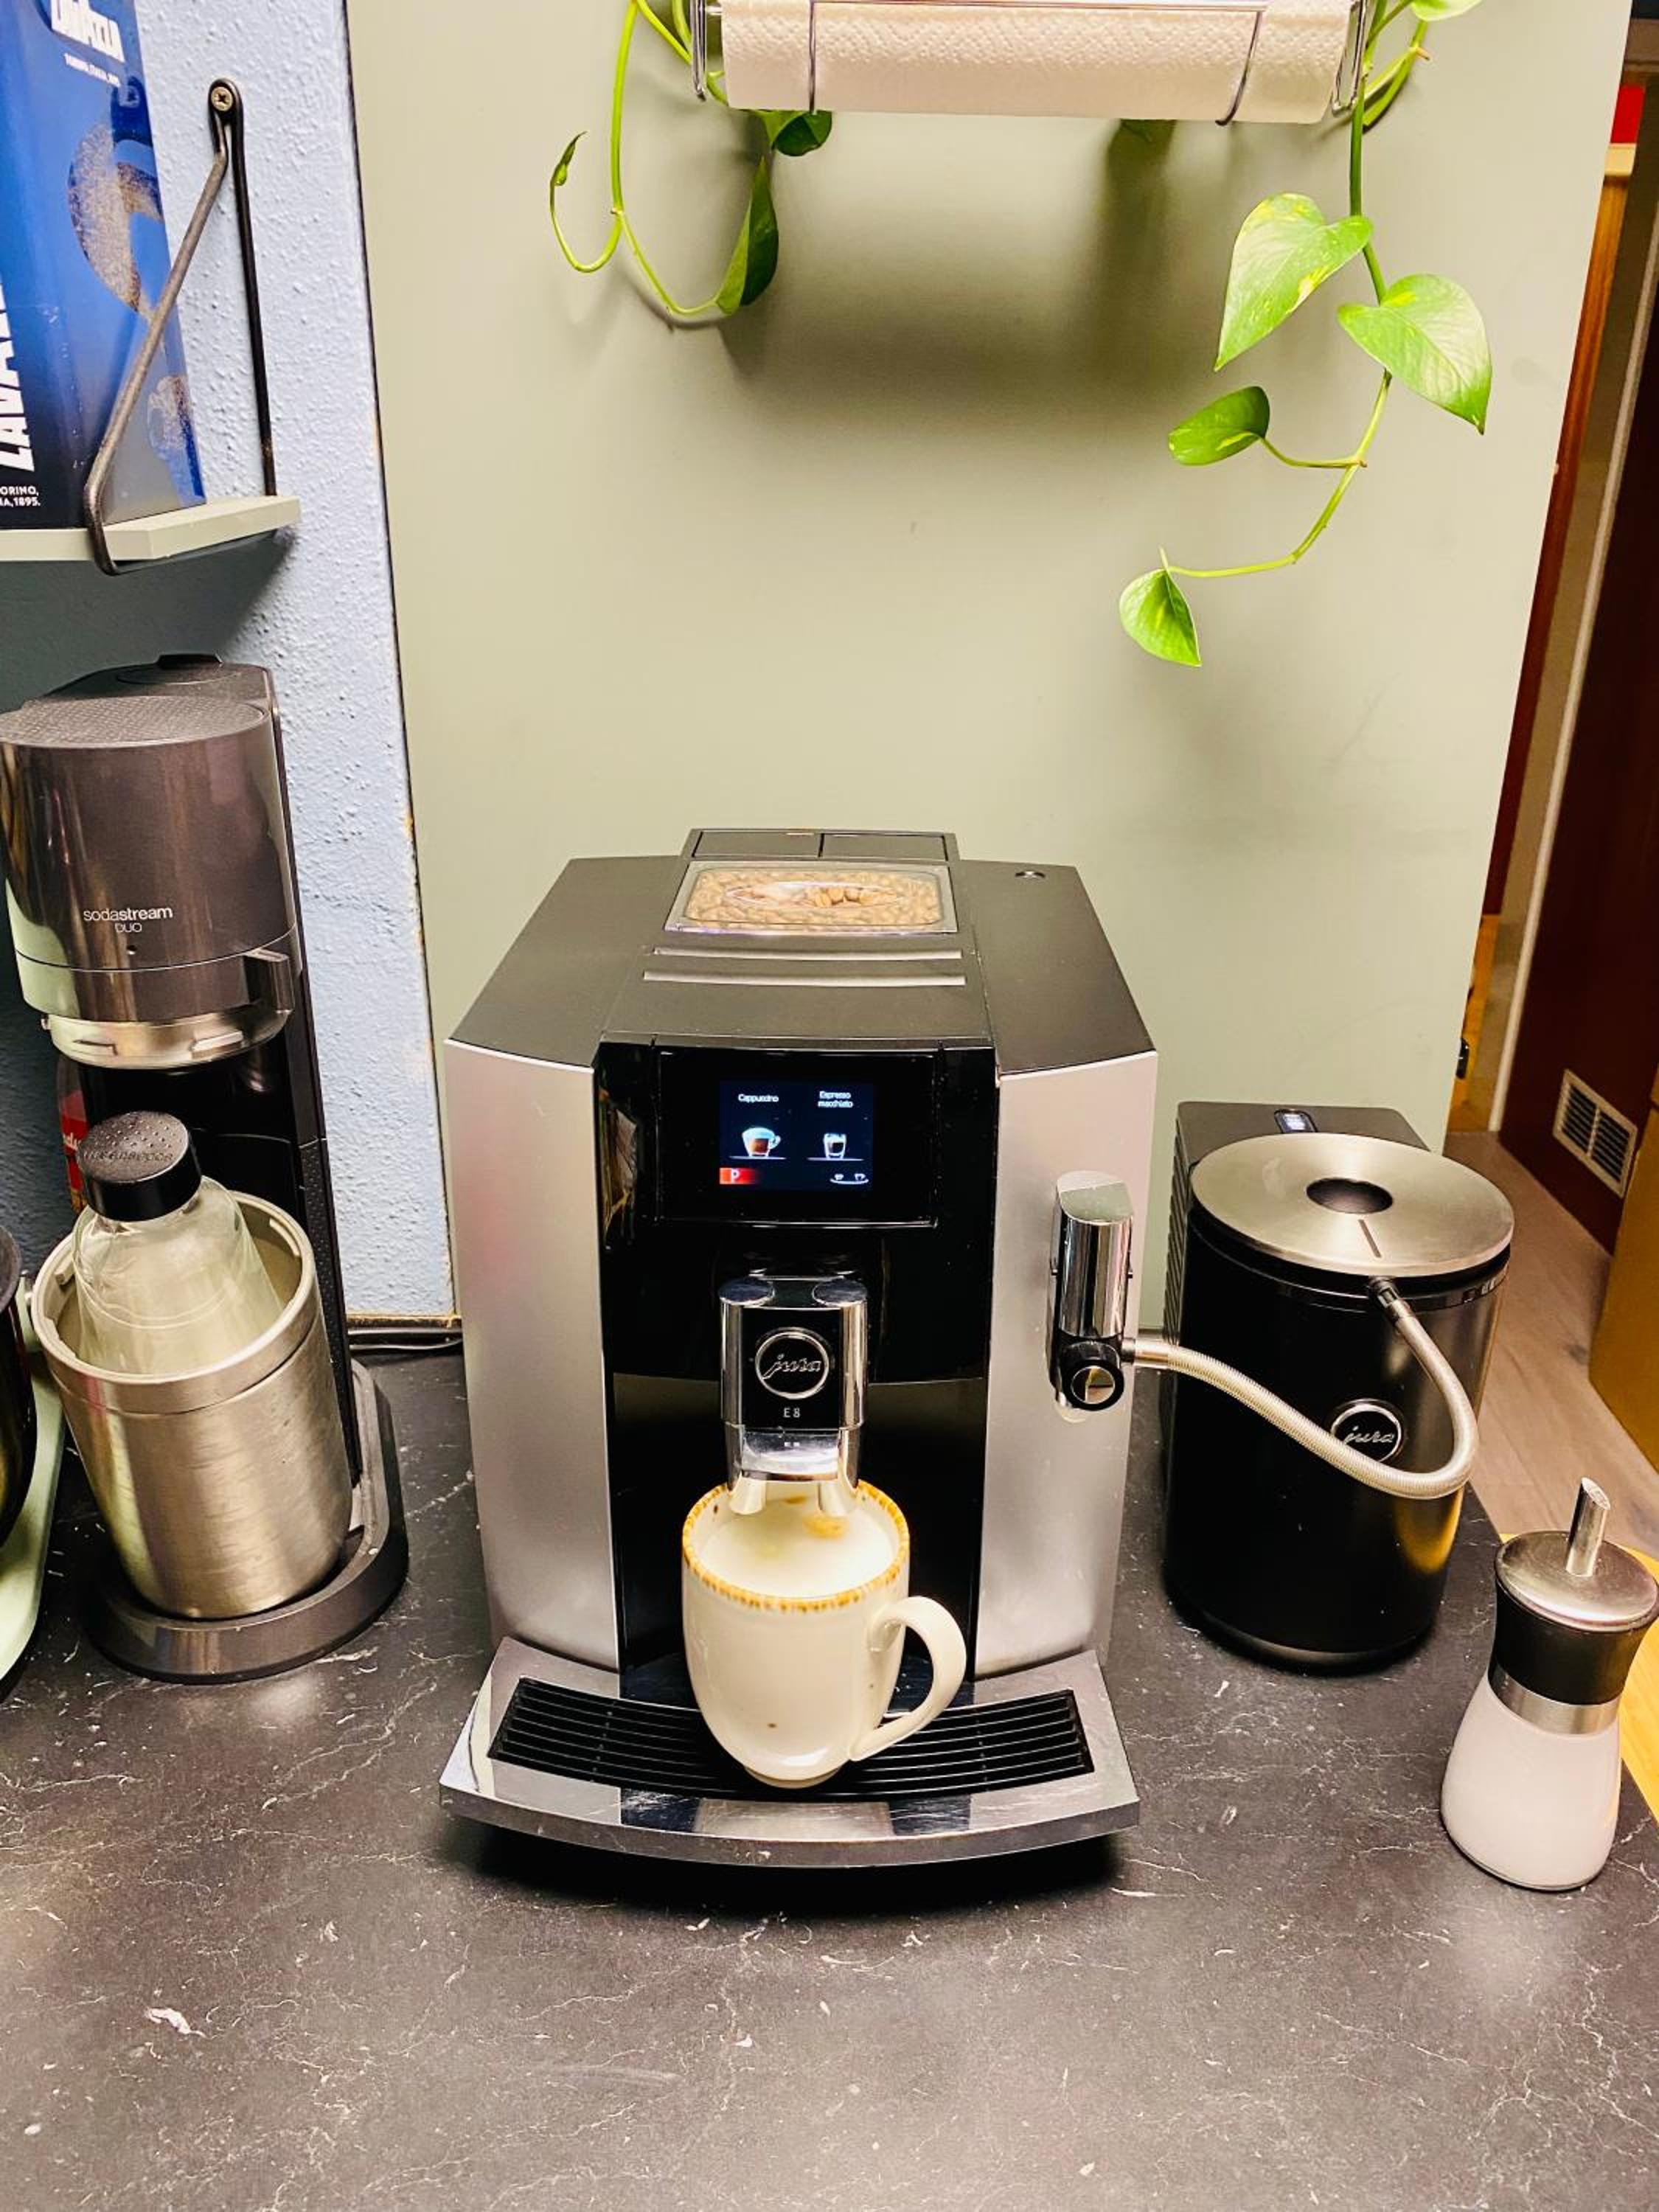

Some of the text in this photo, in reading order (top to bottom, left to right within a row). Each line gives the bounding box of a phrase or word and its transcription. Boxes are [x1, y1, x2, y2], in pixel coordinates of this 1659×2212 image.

[0, 486, 39, 496] ORINO,
[83, 907, 174, 921] sodastream
[114, 922, 142, 933] DUO
[738, 1093, 779, 1103] Cappuccino
[819, 1091, 852, 1100] Espresso
[731, 1168, 740, 1183] P
